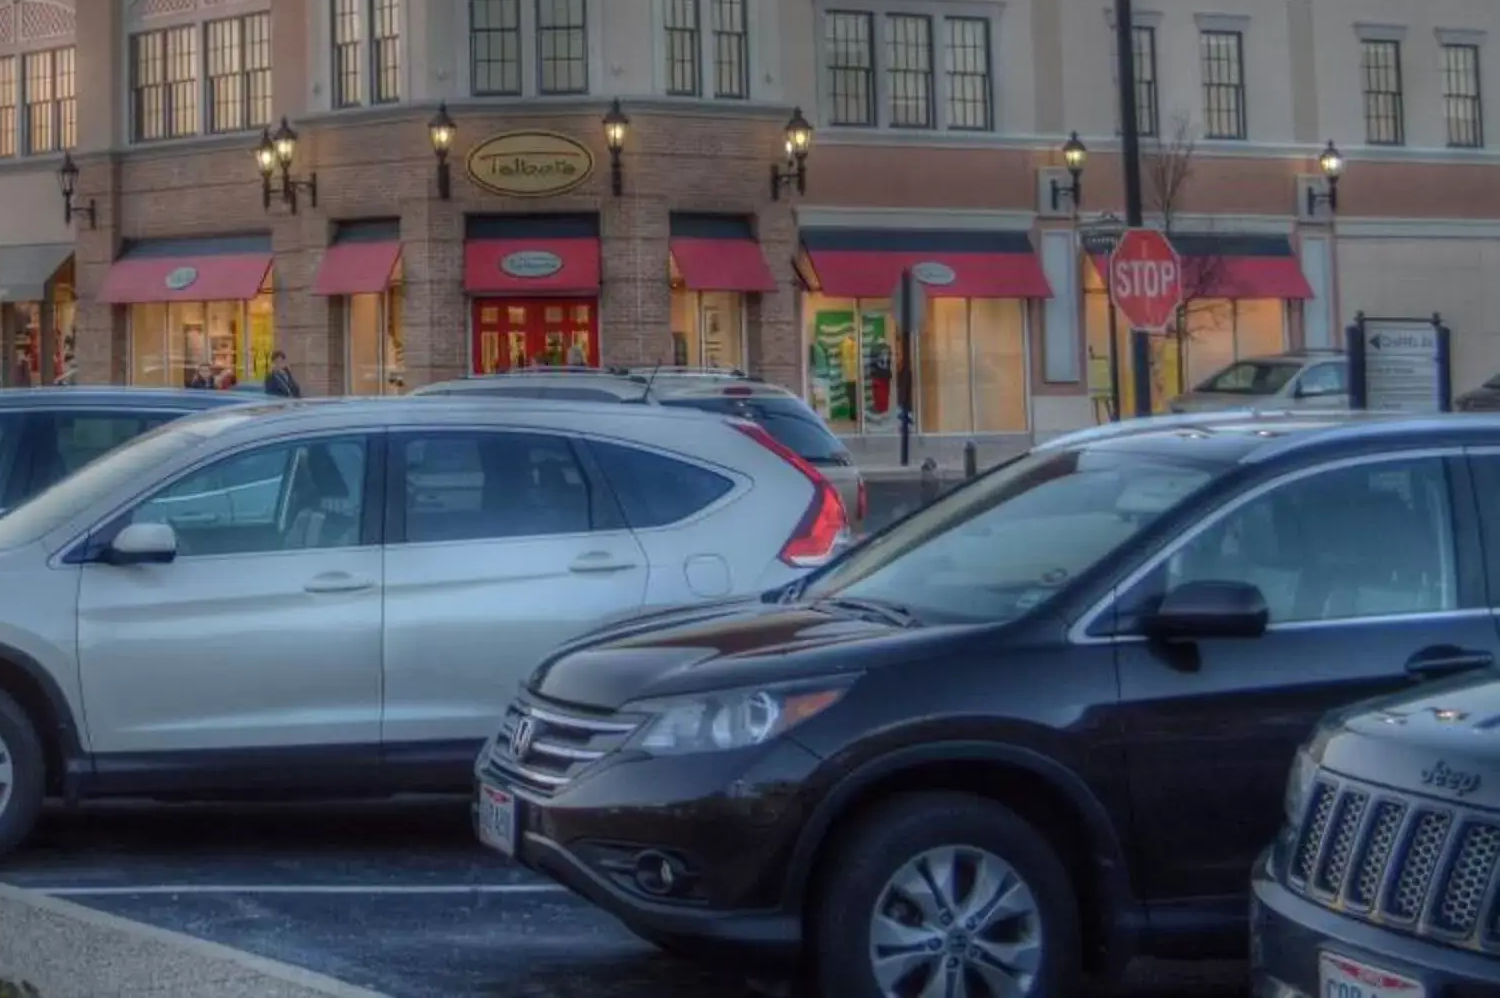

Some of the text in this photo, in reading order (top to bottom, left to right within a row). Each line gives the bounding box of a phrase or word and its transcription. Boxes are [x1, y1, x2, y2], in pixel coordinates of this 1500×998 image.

[481, 152, 580, 176] Talbots
[1116, 262, 1176, 298] STOP
[1421, 760, 1482, 797] Jeep
